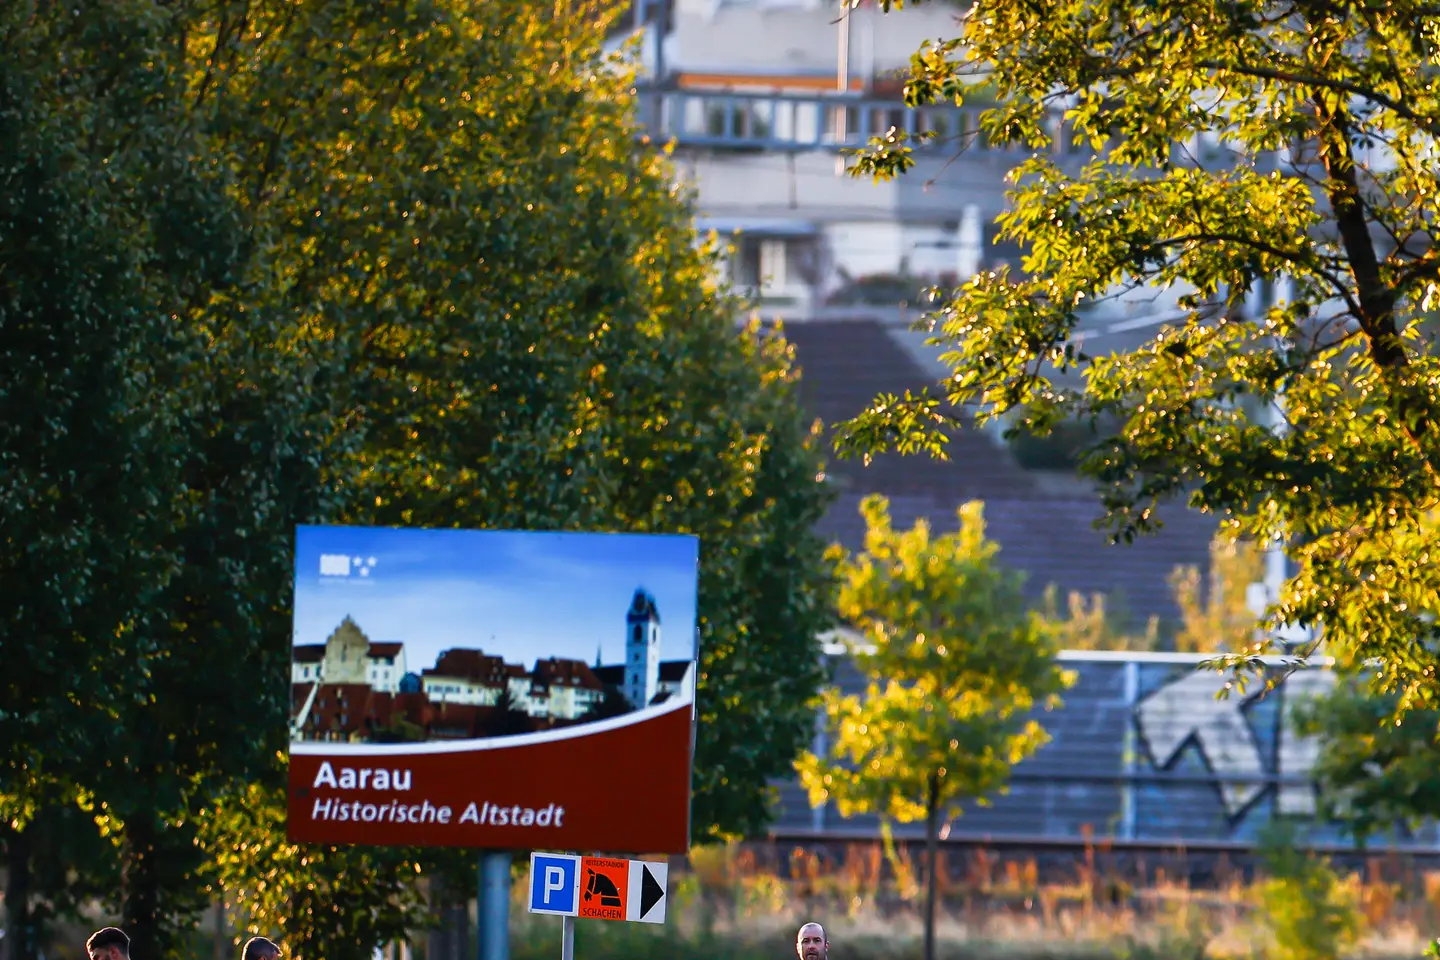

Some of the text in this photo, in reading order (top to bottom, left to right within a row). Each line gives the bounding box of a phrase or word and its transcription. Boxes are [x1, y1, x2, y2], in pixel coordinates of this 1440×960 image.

[313, 760, 412, 791] Aarau
[311, 797, 565, 827] Historische Altstadt
[543, 865, 565, 904] P
[583, 907, 622, 919] SCHACHEN
